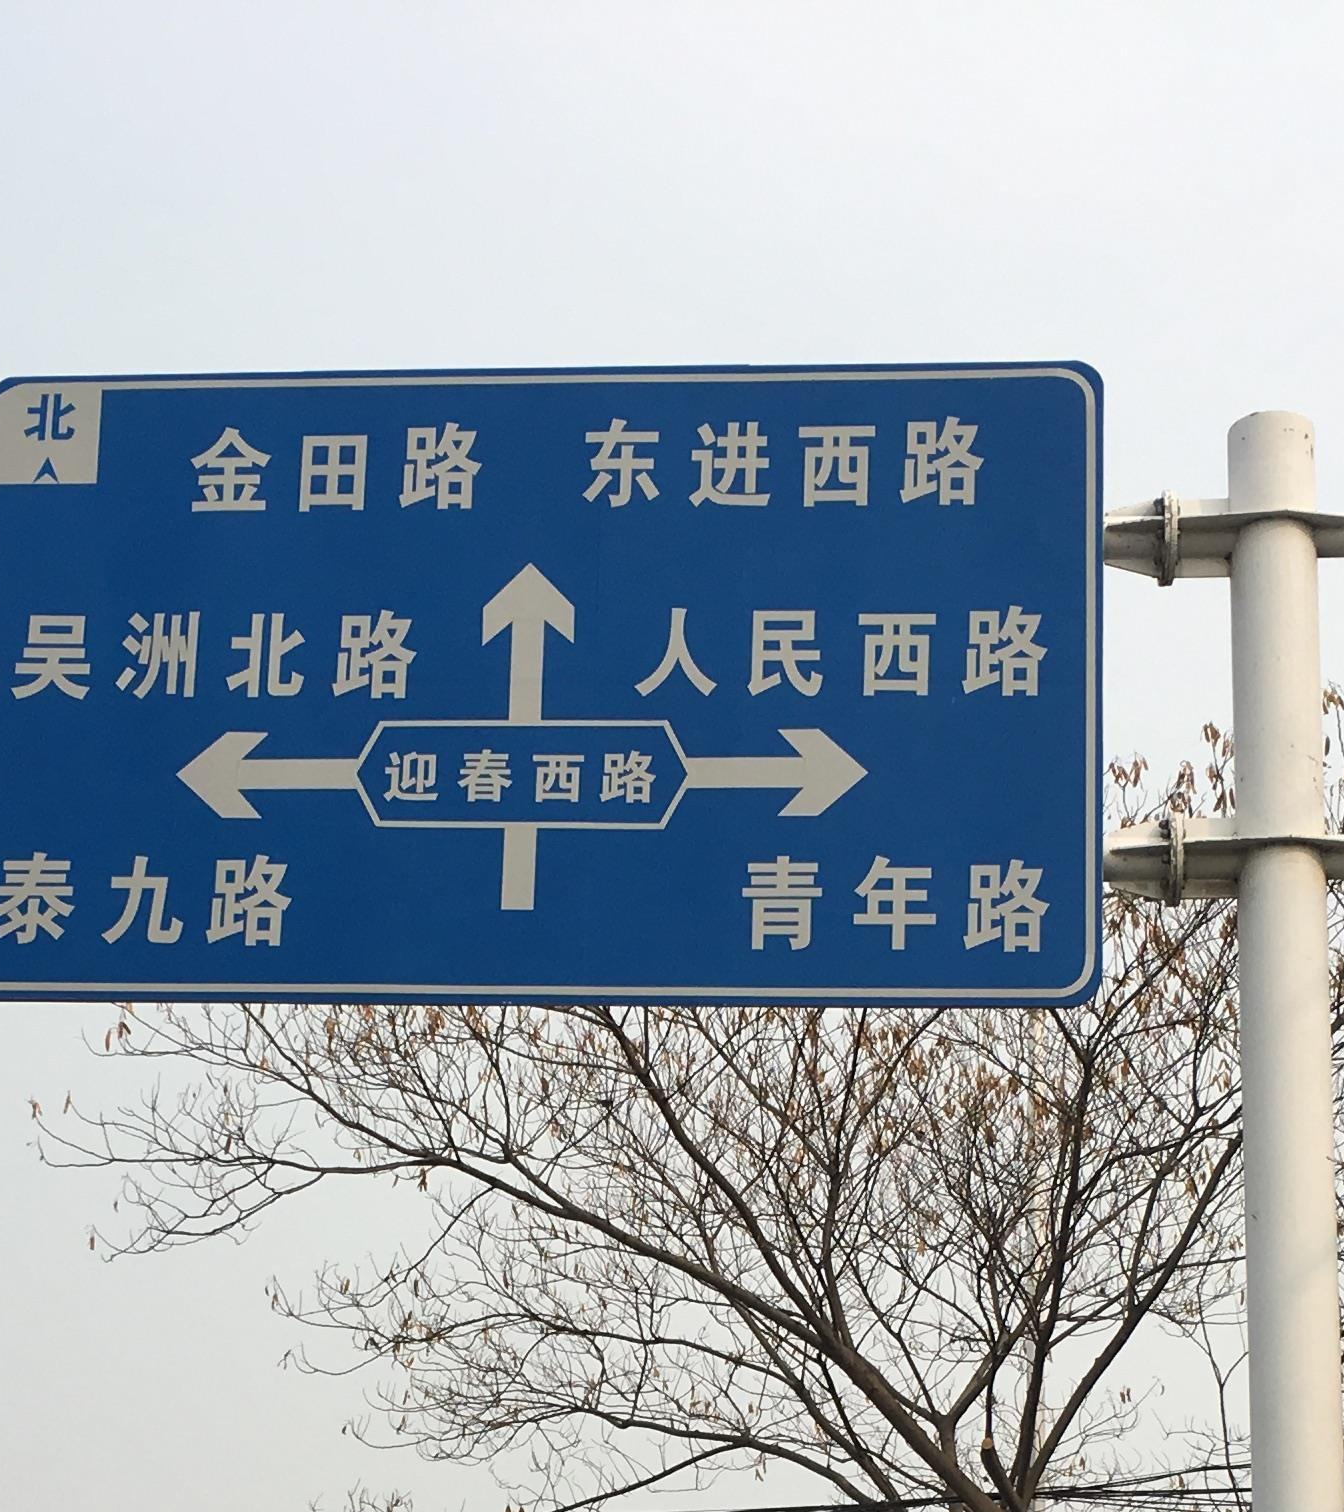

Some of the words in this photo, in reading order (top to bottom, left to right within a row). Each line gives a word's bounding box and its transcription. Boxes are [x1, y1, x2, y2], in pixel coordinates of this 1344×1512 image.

[25, 392, 77, 443] 北
[190, 424, 484, 514] 金田路
[581, 416, 986, 510] 东进西路
[11, 610, 419, 701] 吴洲北路
[633, 605, 1049, 699] 人民西路
[383, 749, 659, 806] 迎春西路
[741, 855, 1052, 954] 青年路
